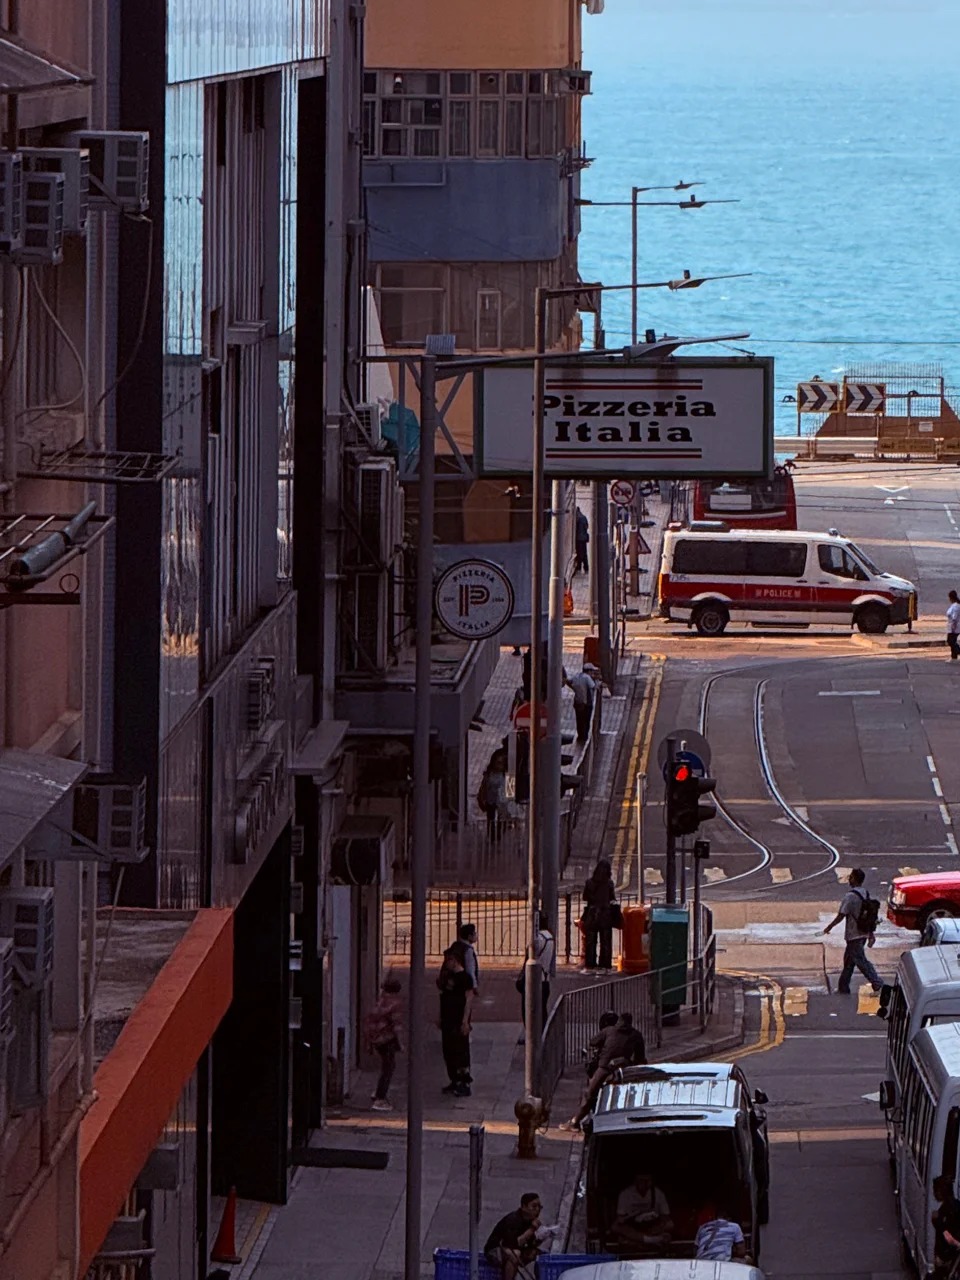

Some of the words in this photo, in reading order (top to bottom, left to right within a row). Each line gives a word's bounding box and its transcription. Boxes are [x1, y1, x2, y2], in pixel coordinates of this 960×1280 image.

[533, 395, 716, 417] Pizzeria
[555, 421, 693, 442] Italia
[763, 589, 793, 598] POLICE
